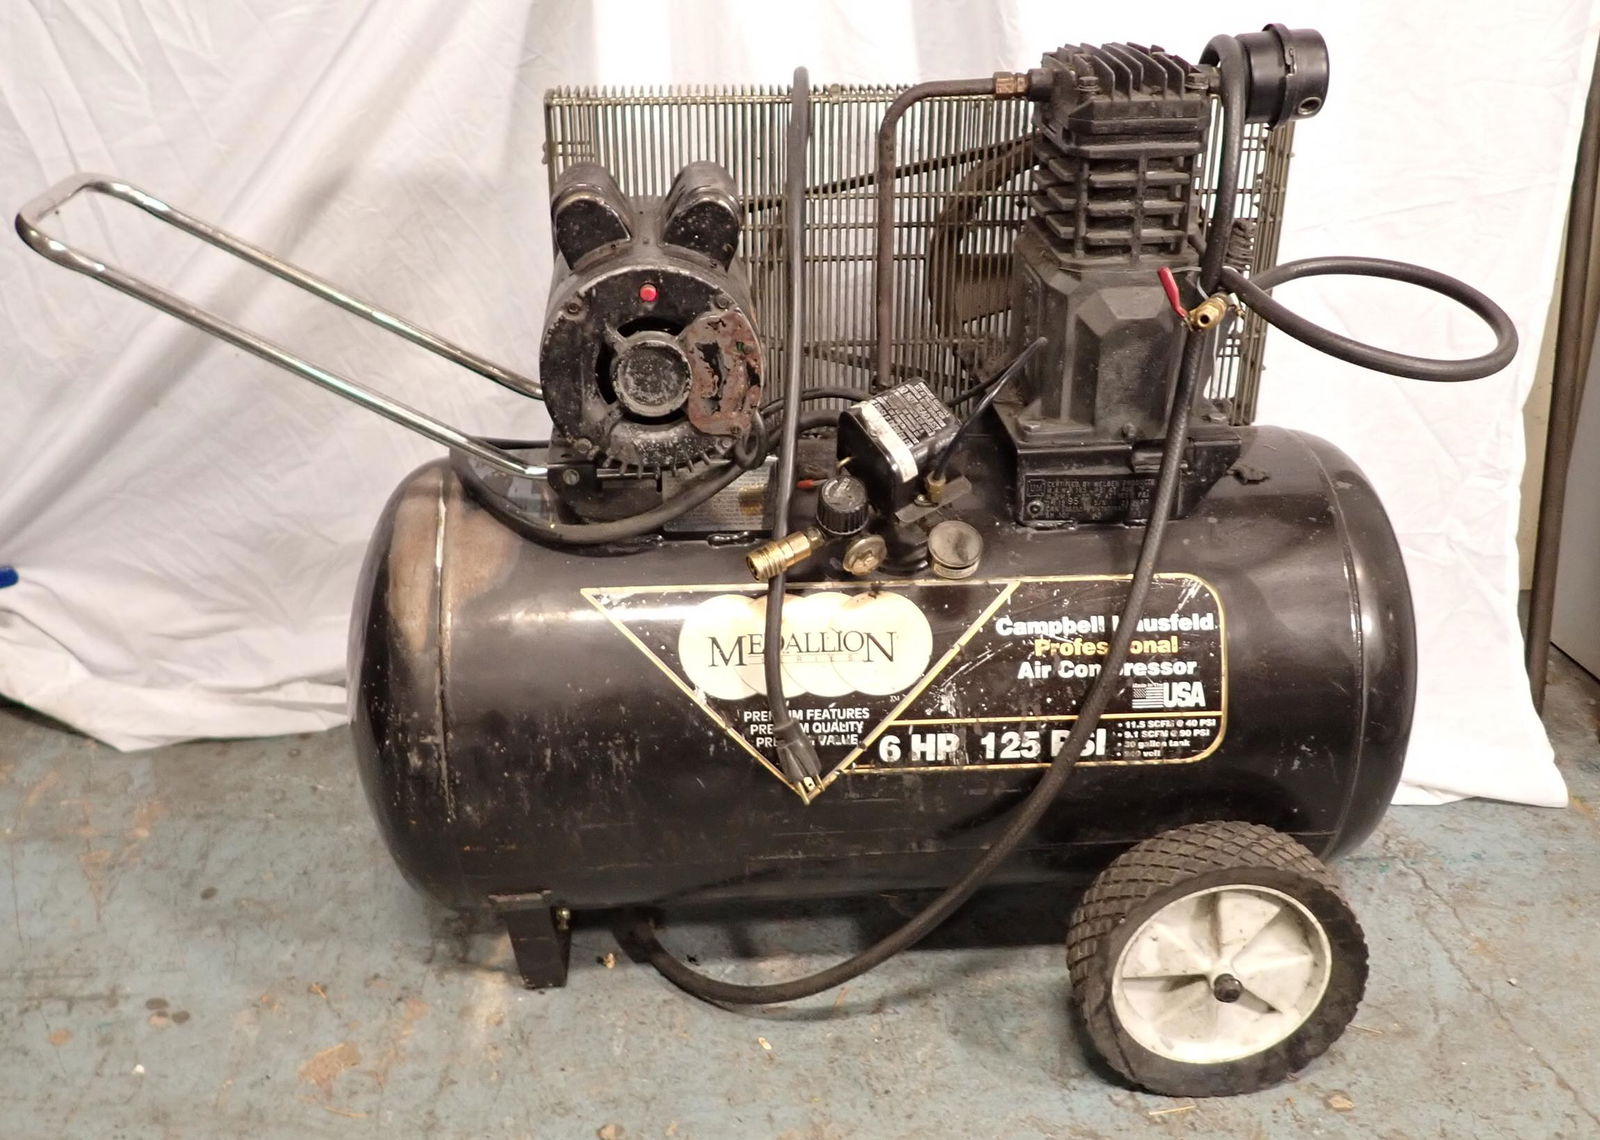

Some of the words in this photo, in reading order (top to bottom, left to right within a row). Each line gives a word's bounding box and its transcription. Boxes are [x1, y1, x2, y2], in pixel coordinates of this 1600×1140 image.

[995, 615, 1105, 636] Campbell
[708, 630, 895, 667] MEALLION
[1034, 635, 1179, 657] Profesonal
[1017, 661, 1052, 680] Air
[1058, 660, 1198, 678] Coressor
[1163, 681, 1206, 708] USA
[743, 709, 803, 723] PREM
[806, 707, 870, 721] FEATURES
[1185, 719, 1198, 727] 40
[1199, 718, 1216, 727] PSI
[812, 721, 864, 734] QUALITY
[1193, 728, 1210, 737] PSI
[818, 734, 859, 747] VALUE
[879, 735, 901, 763] 6
[911, 733, 960, 761] HP
[981, 731, 1042, 759] 125
